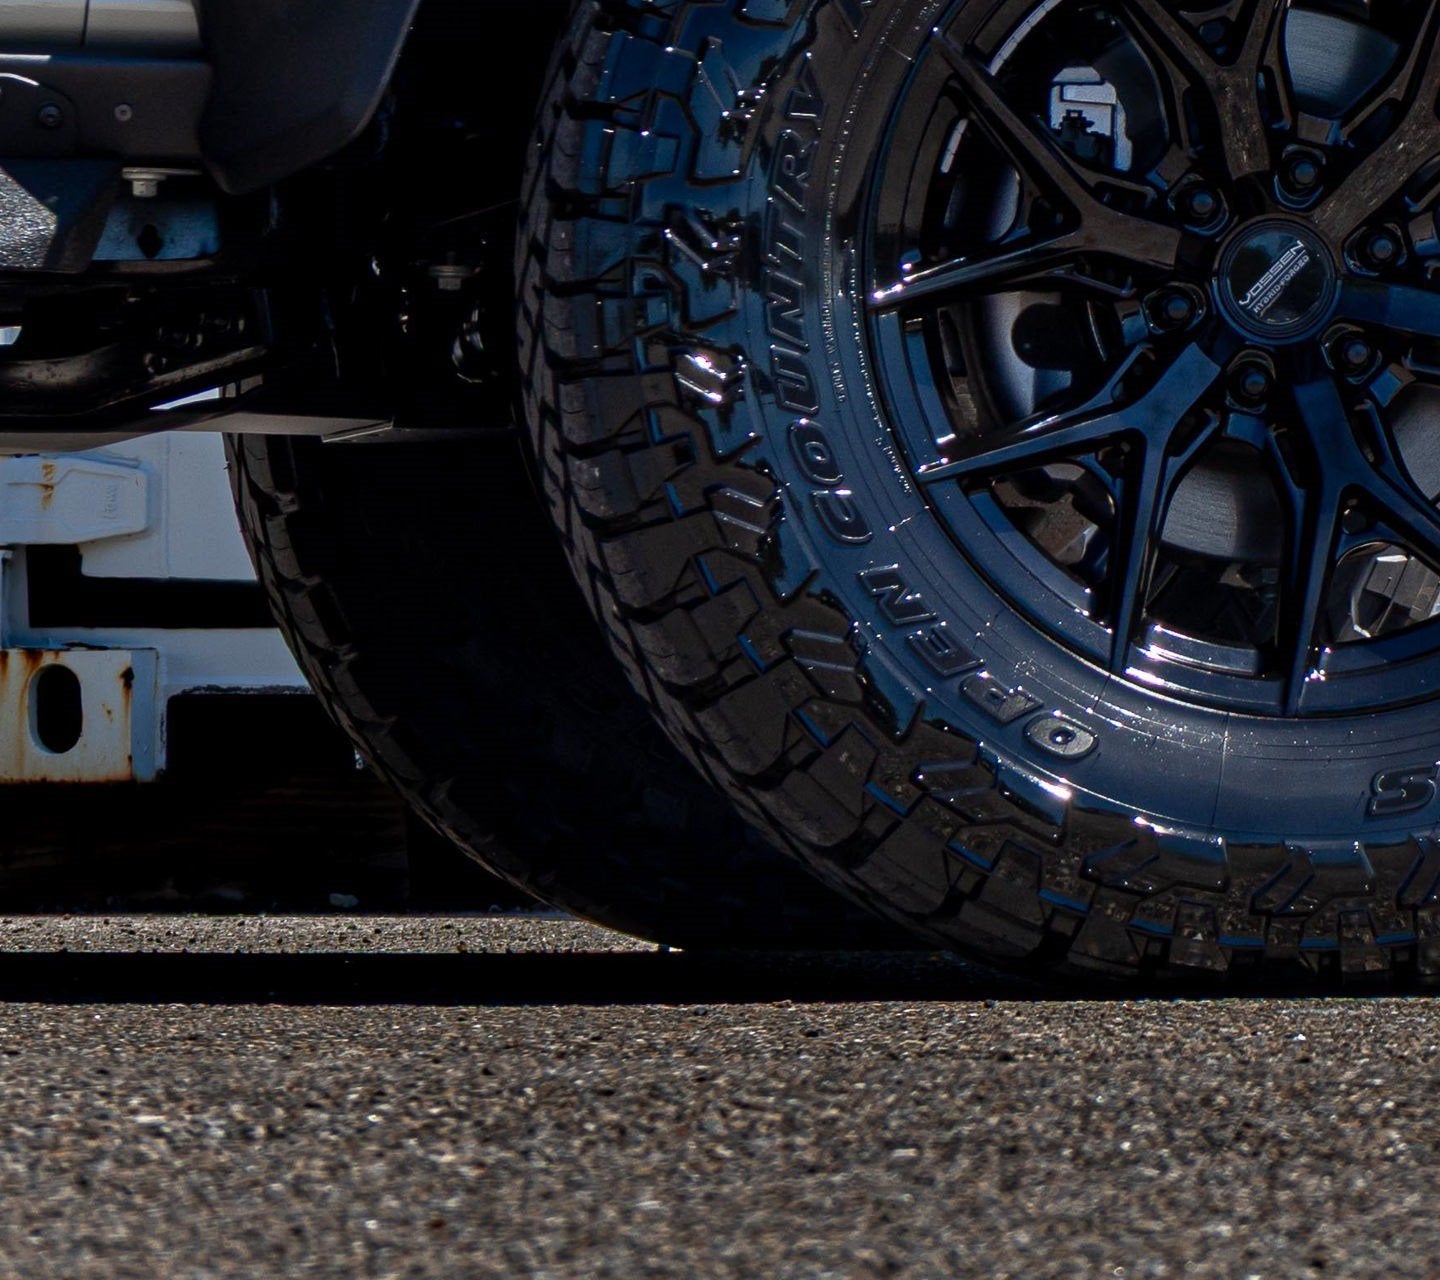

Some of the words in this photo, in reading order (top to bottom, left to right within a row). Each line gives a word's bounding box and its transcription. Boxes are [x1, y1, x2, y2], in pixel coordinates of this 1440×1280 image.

[762, 48, 874, 546] COUNTRY
[1239, 239, 1305, 305] VOSSEN
[858, 560, 1098, 760] OPEN
